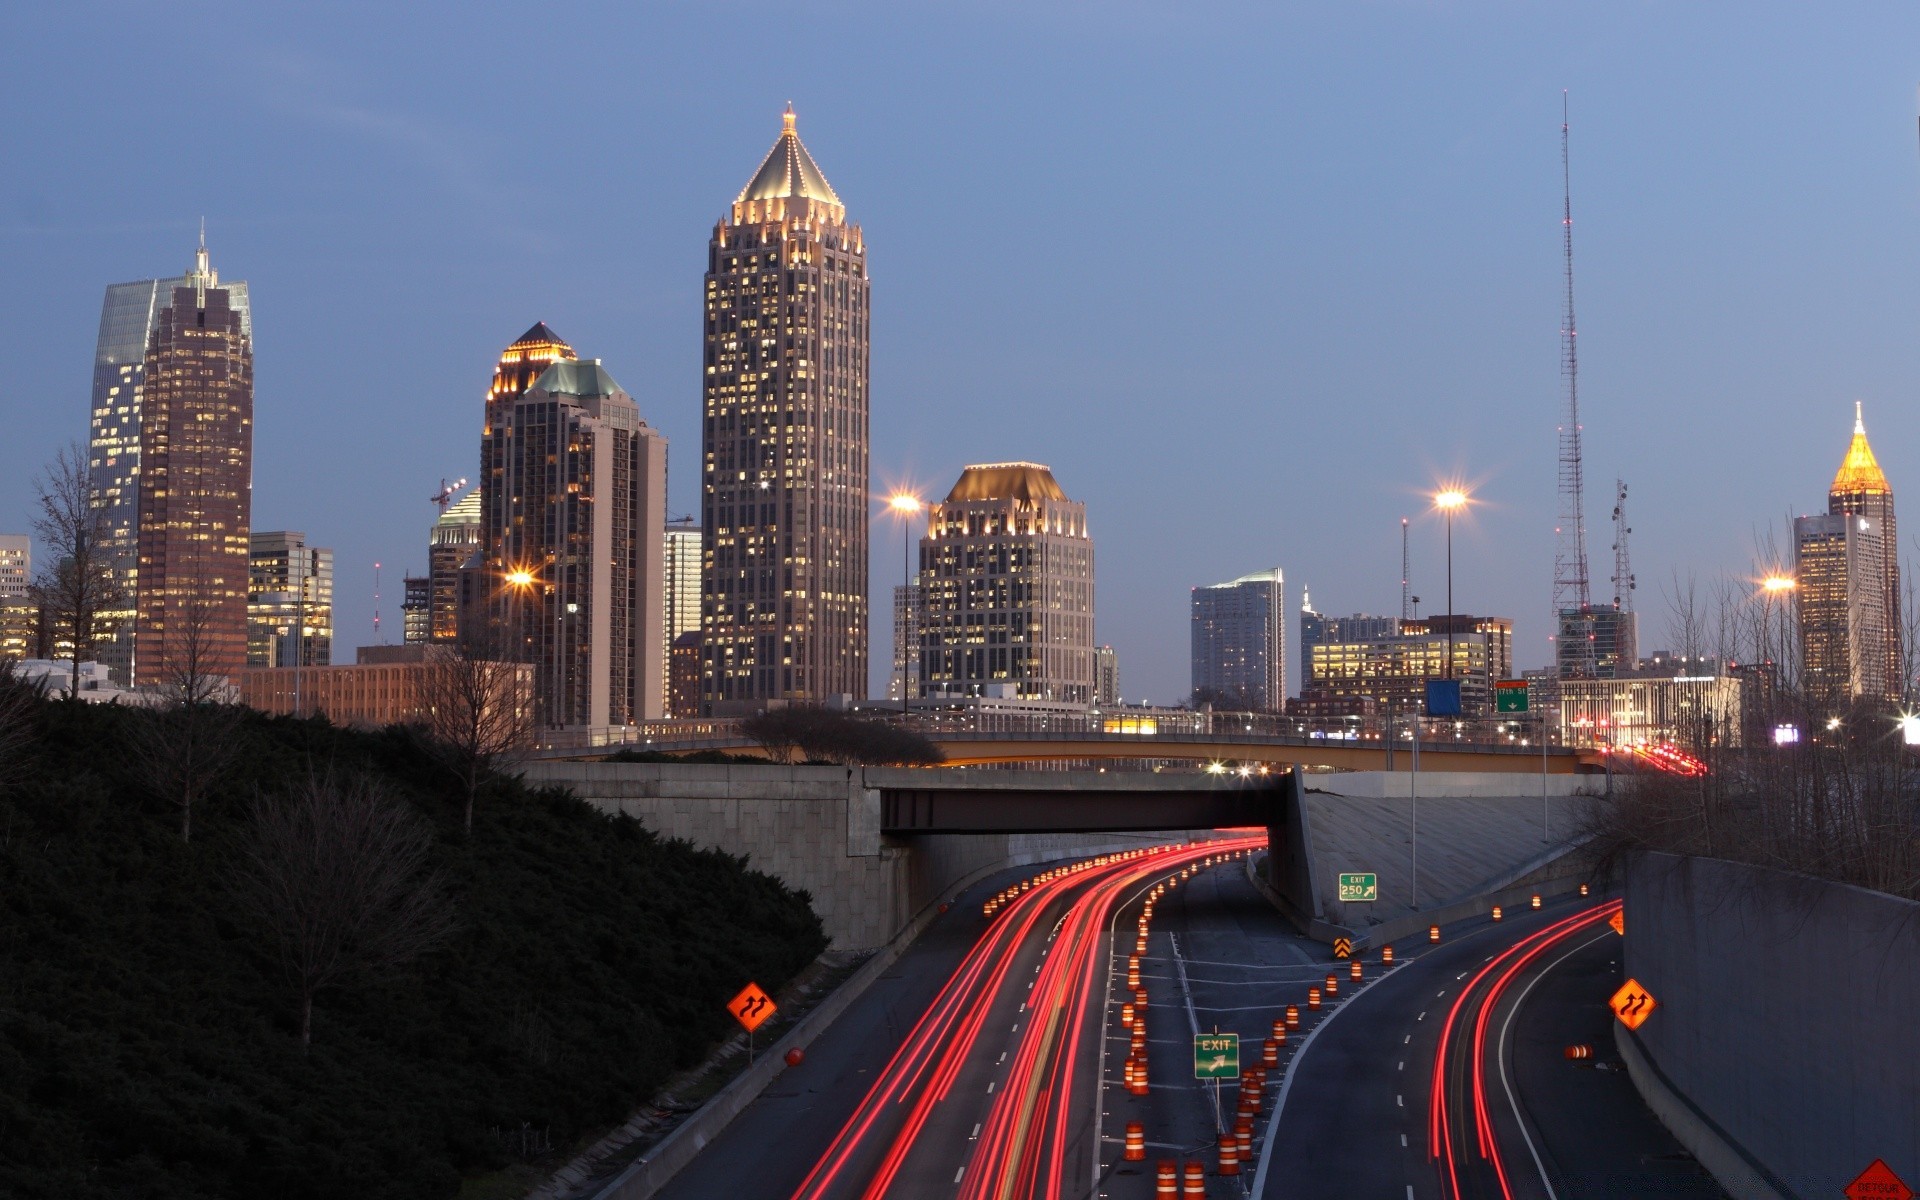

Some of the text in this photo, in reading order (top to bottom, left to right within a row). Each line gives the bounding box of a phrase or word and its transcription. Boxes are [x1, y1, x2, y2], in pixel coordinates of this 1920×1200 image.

[1341, 885, 1363, 895] 250
[1202, 1040, 1230, 1050] EXIT
[1857, 1182, 1899, 1193] DETOUR
